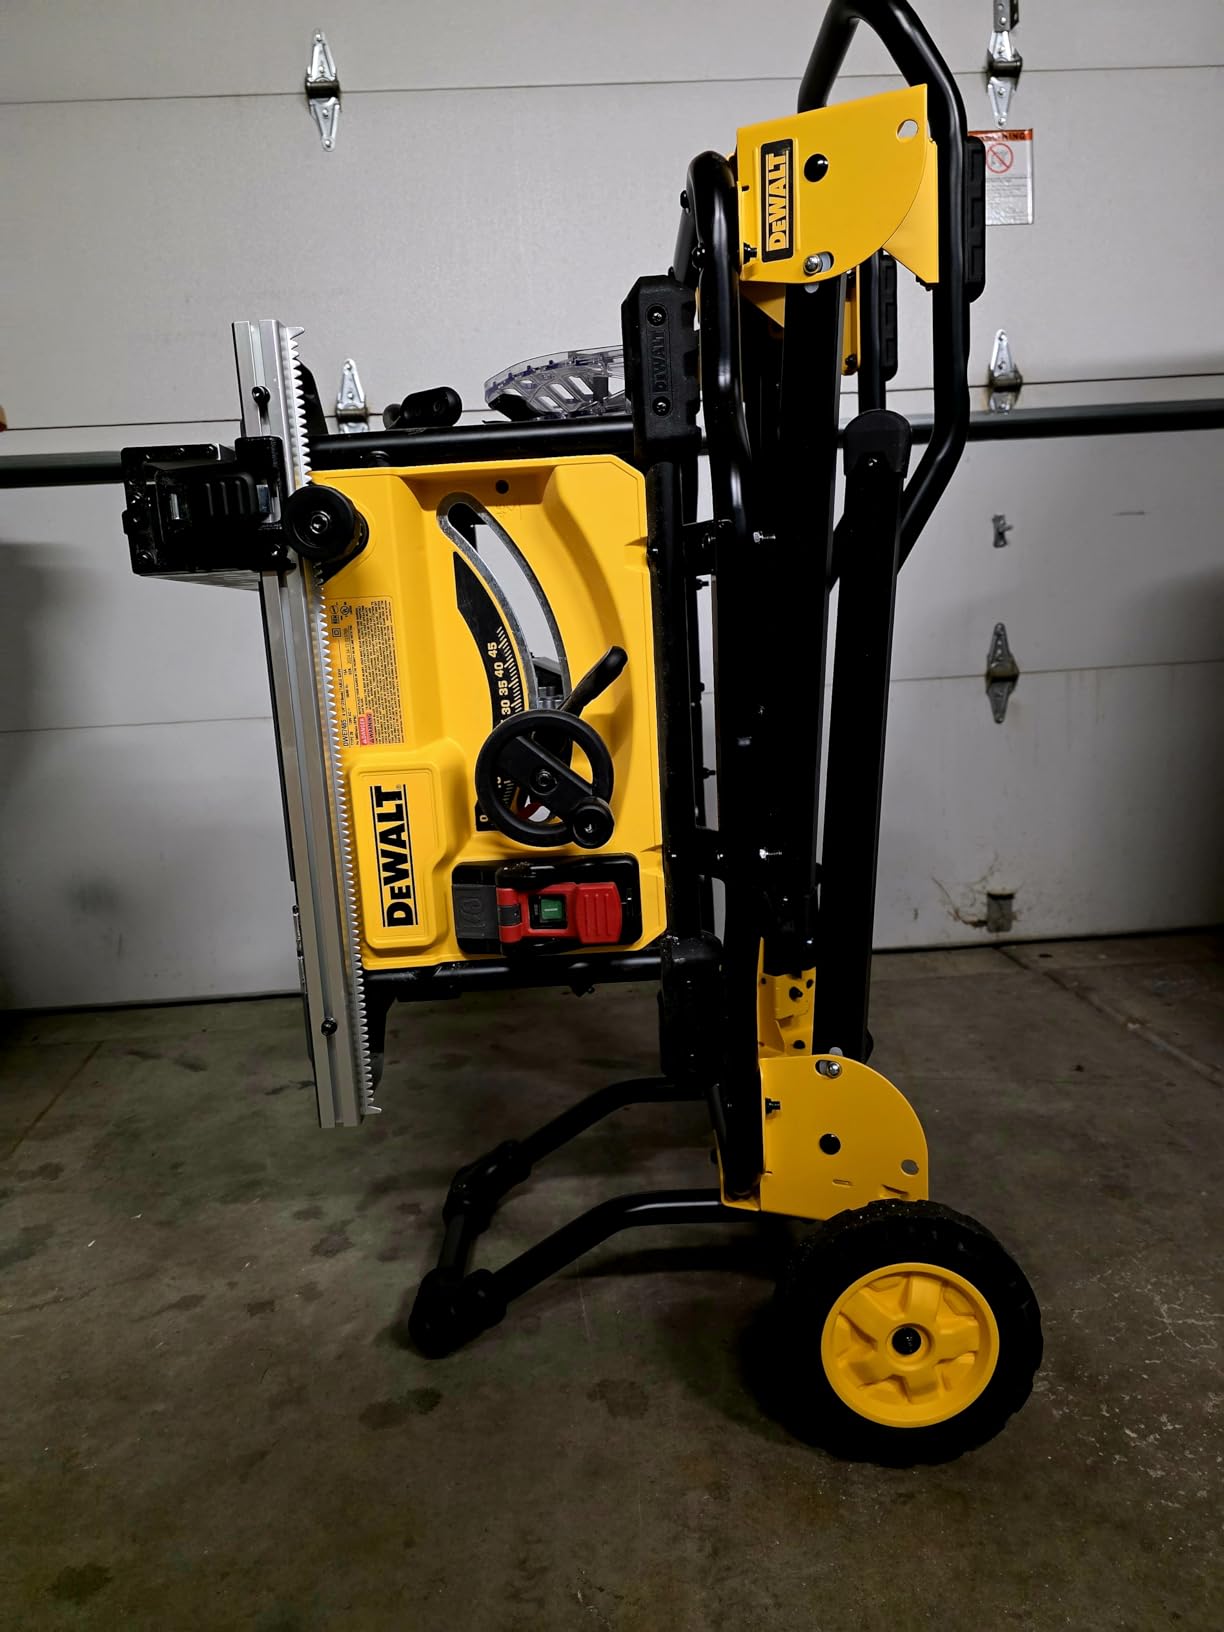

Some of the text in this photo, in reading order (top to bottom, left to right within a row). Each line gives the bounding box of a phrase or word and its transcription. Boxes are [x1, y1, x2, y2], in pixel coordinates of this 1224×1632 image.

[767, 152, 787, 251] DEWALT
[487, 641, 498, 658] 45
[493, 661, 505, 678] 40
[499, 679, 508, 696] 35
[501, 699, 512, 715] 30
[373, 785, 414, 928] DEWALT
